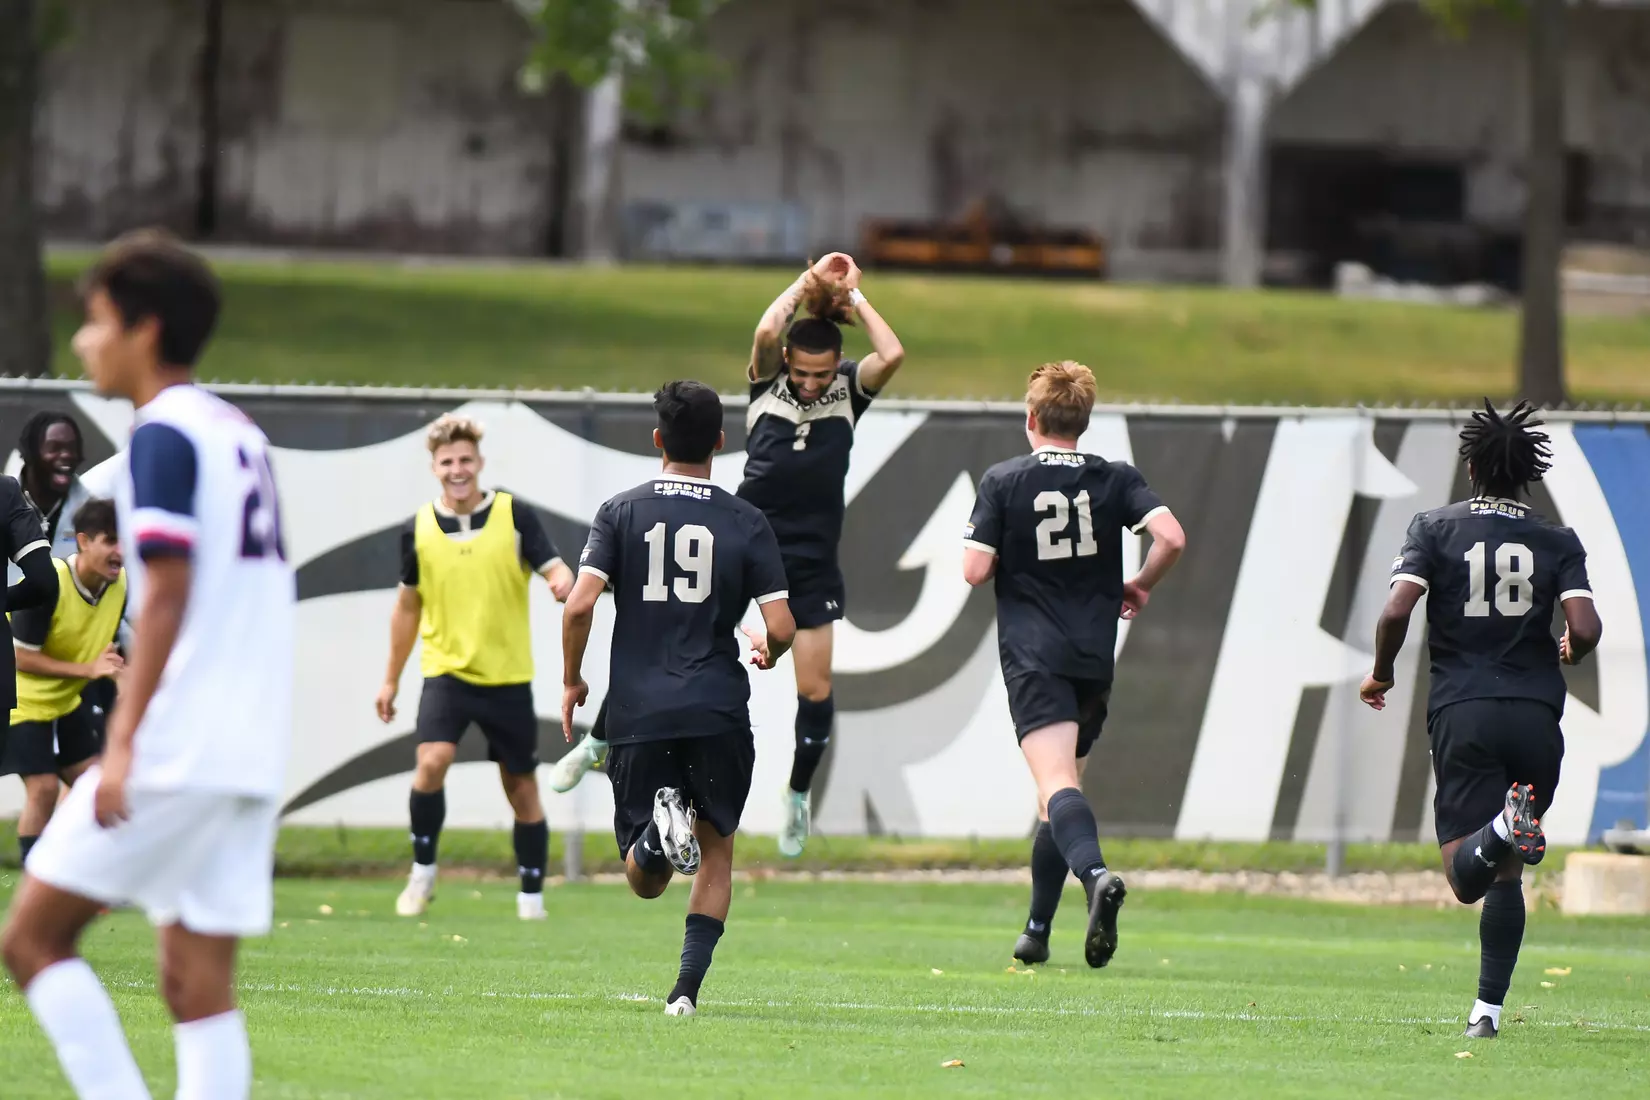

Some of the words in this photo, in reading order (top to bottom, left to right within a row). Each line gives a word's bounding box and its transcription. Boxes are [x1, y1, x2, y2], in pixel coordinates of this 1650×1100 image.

[654, 482, 712, 497] PURDUE
[1033, 489, 1098, 561] 21
[1470, 503, 1526, 517] PURDUE
[642, 521, 715, 603] 19
[1463, 541, 1534, 617] 18
